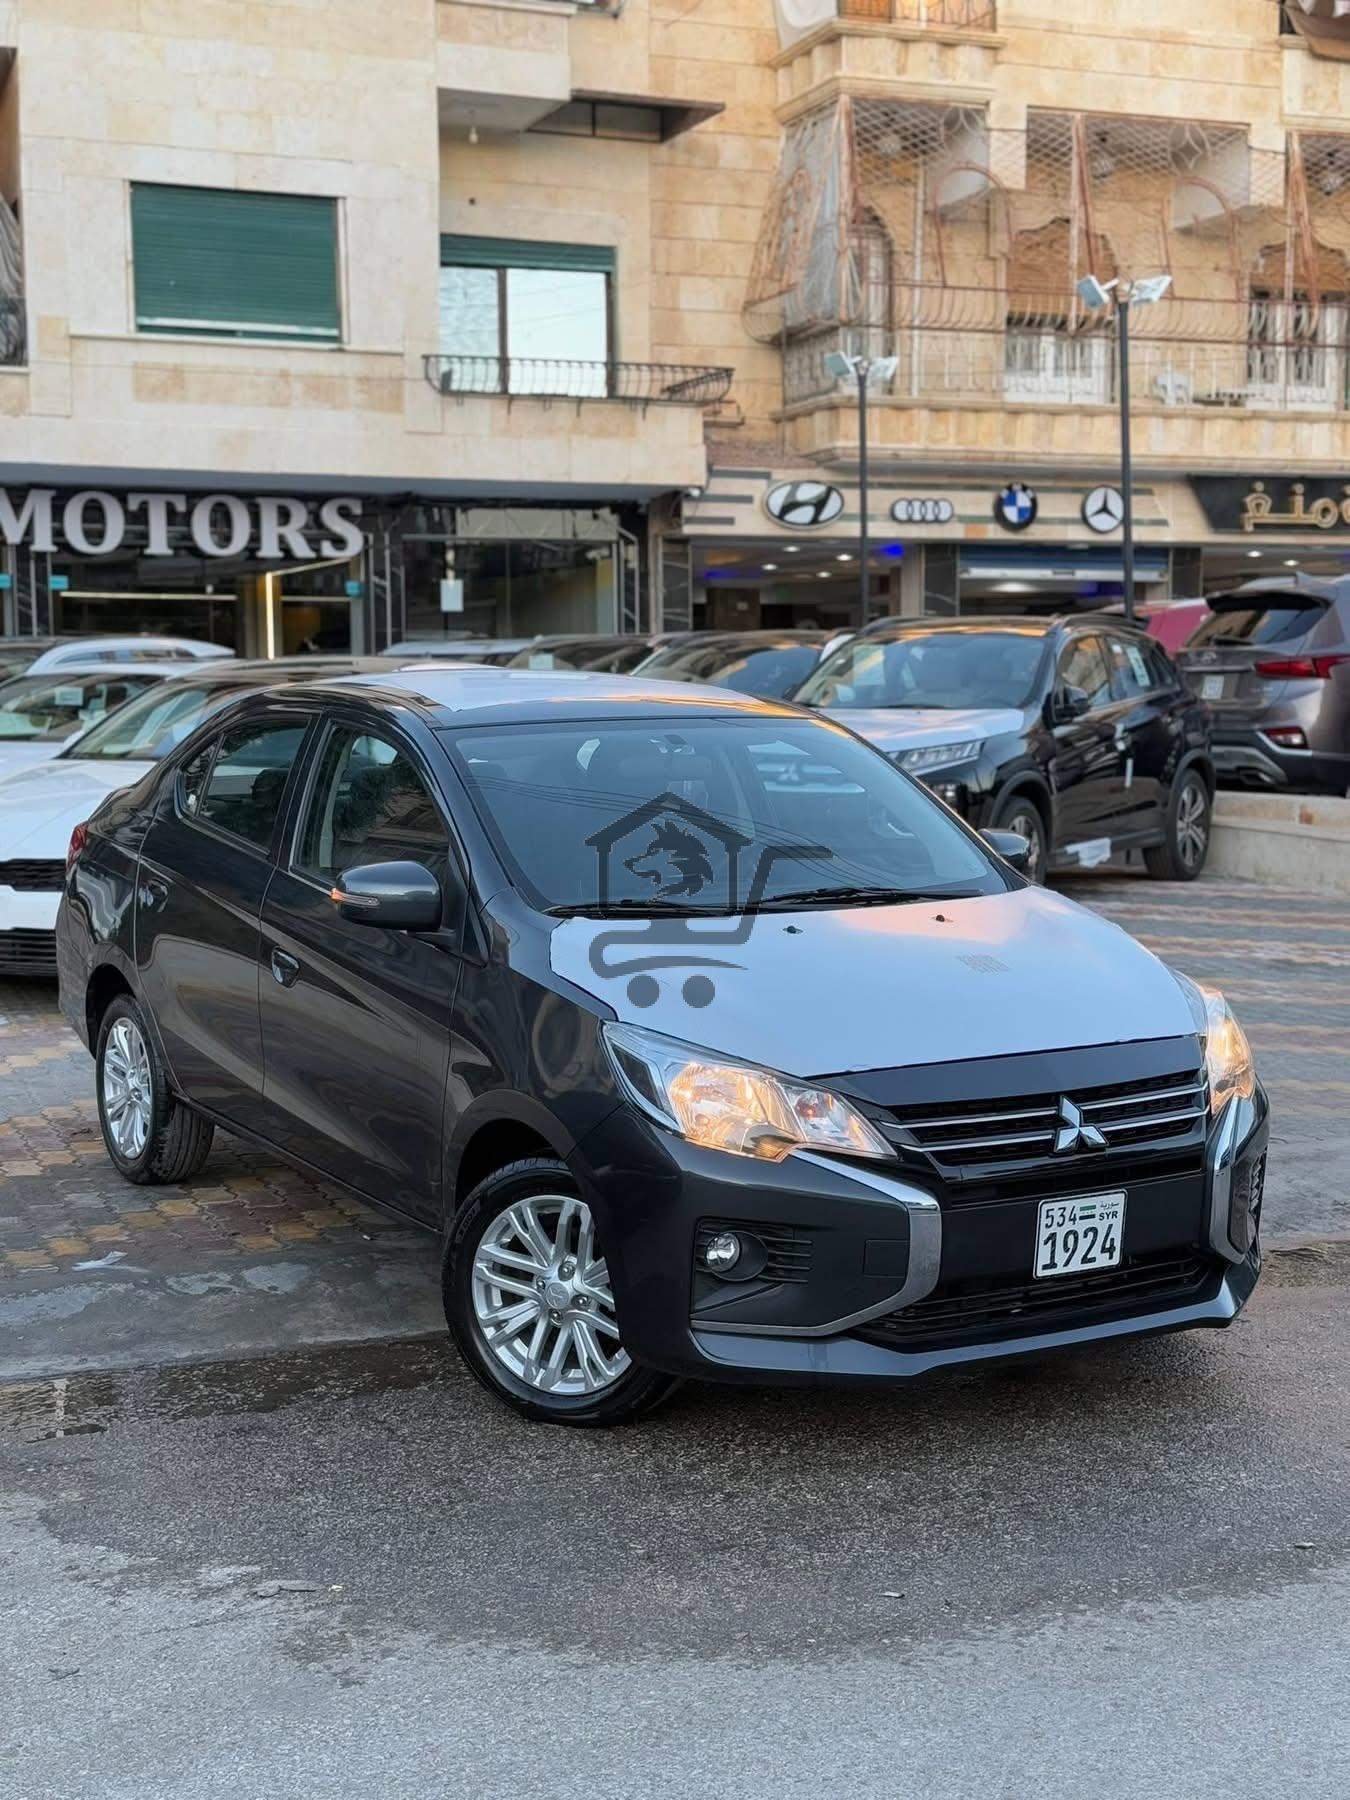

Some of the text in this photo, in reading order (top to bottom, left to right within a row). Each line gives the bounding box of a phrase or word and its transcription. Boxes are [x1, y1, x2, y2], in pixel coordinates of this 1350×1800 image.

[0, 488, 364, 560] MOTORS
[1044, 1205, 1077, 1229] 534
[1098, 1210, 1118, 1221] SYR
[1041, 1223, 1117, 1271] 1924
